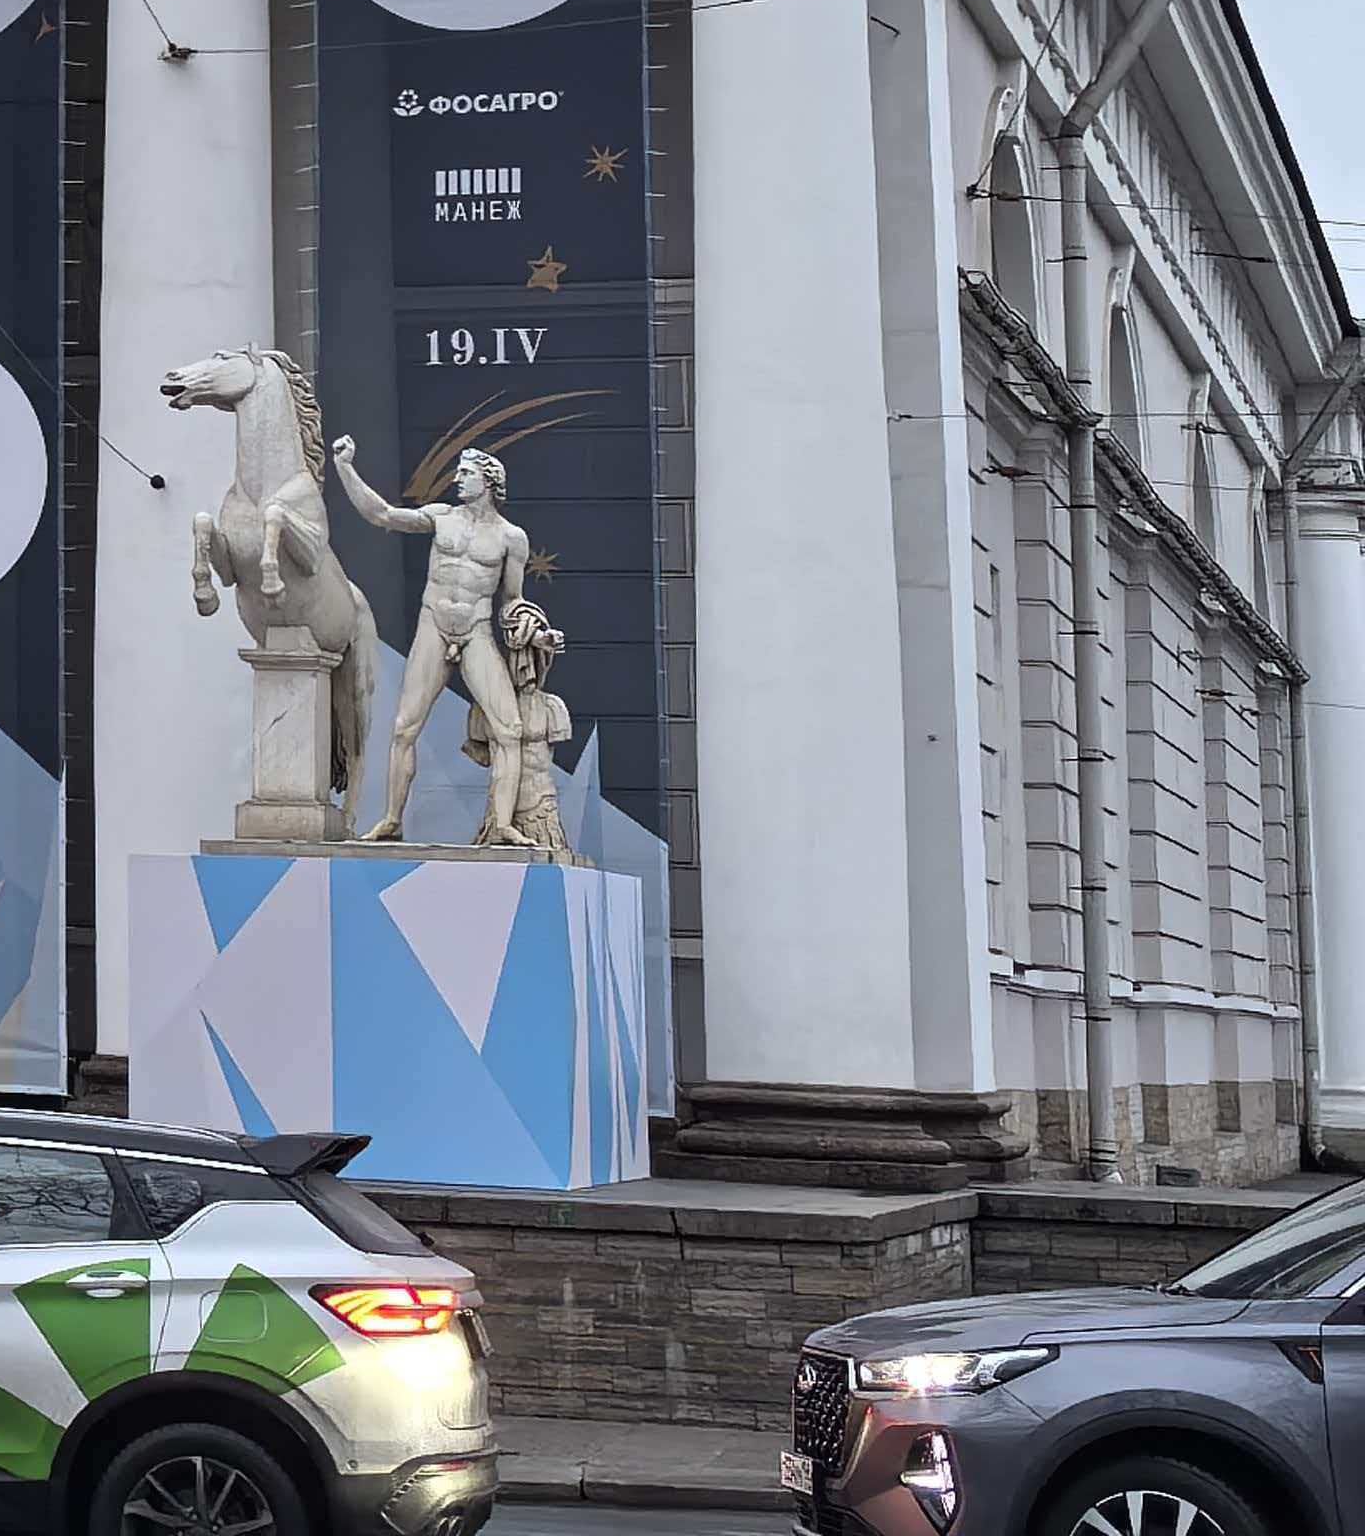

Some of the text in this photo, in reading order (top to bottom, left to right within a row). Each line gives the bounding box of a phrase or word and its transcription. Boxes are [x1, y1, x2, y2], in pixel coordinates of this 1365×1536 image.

[428, 90, 559, 115] ФОСАГРО
[434, 200, 522, 222] МАНЕЖ
[425, 327, 549, 366] 19.IV
